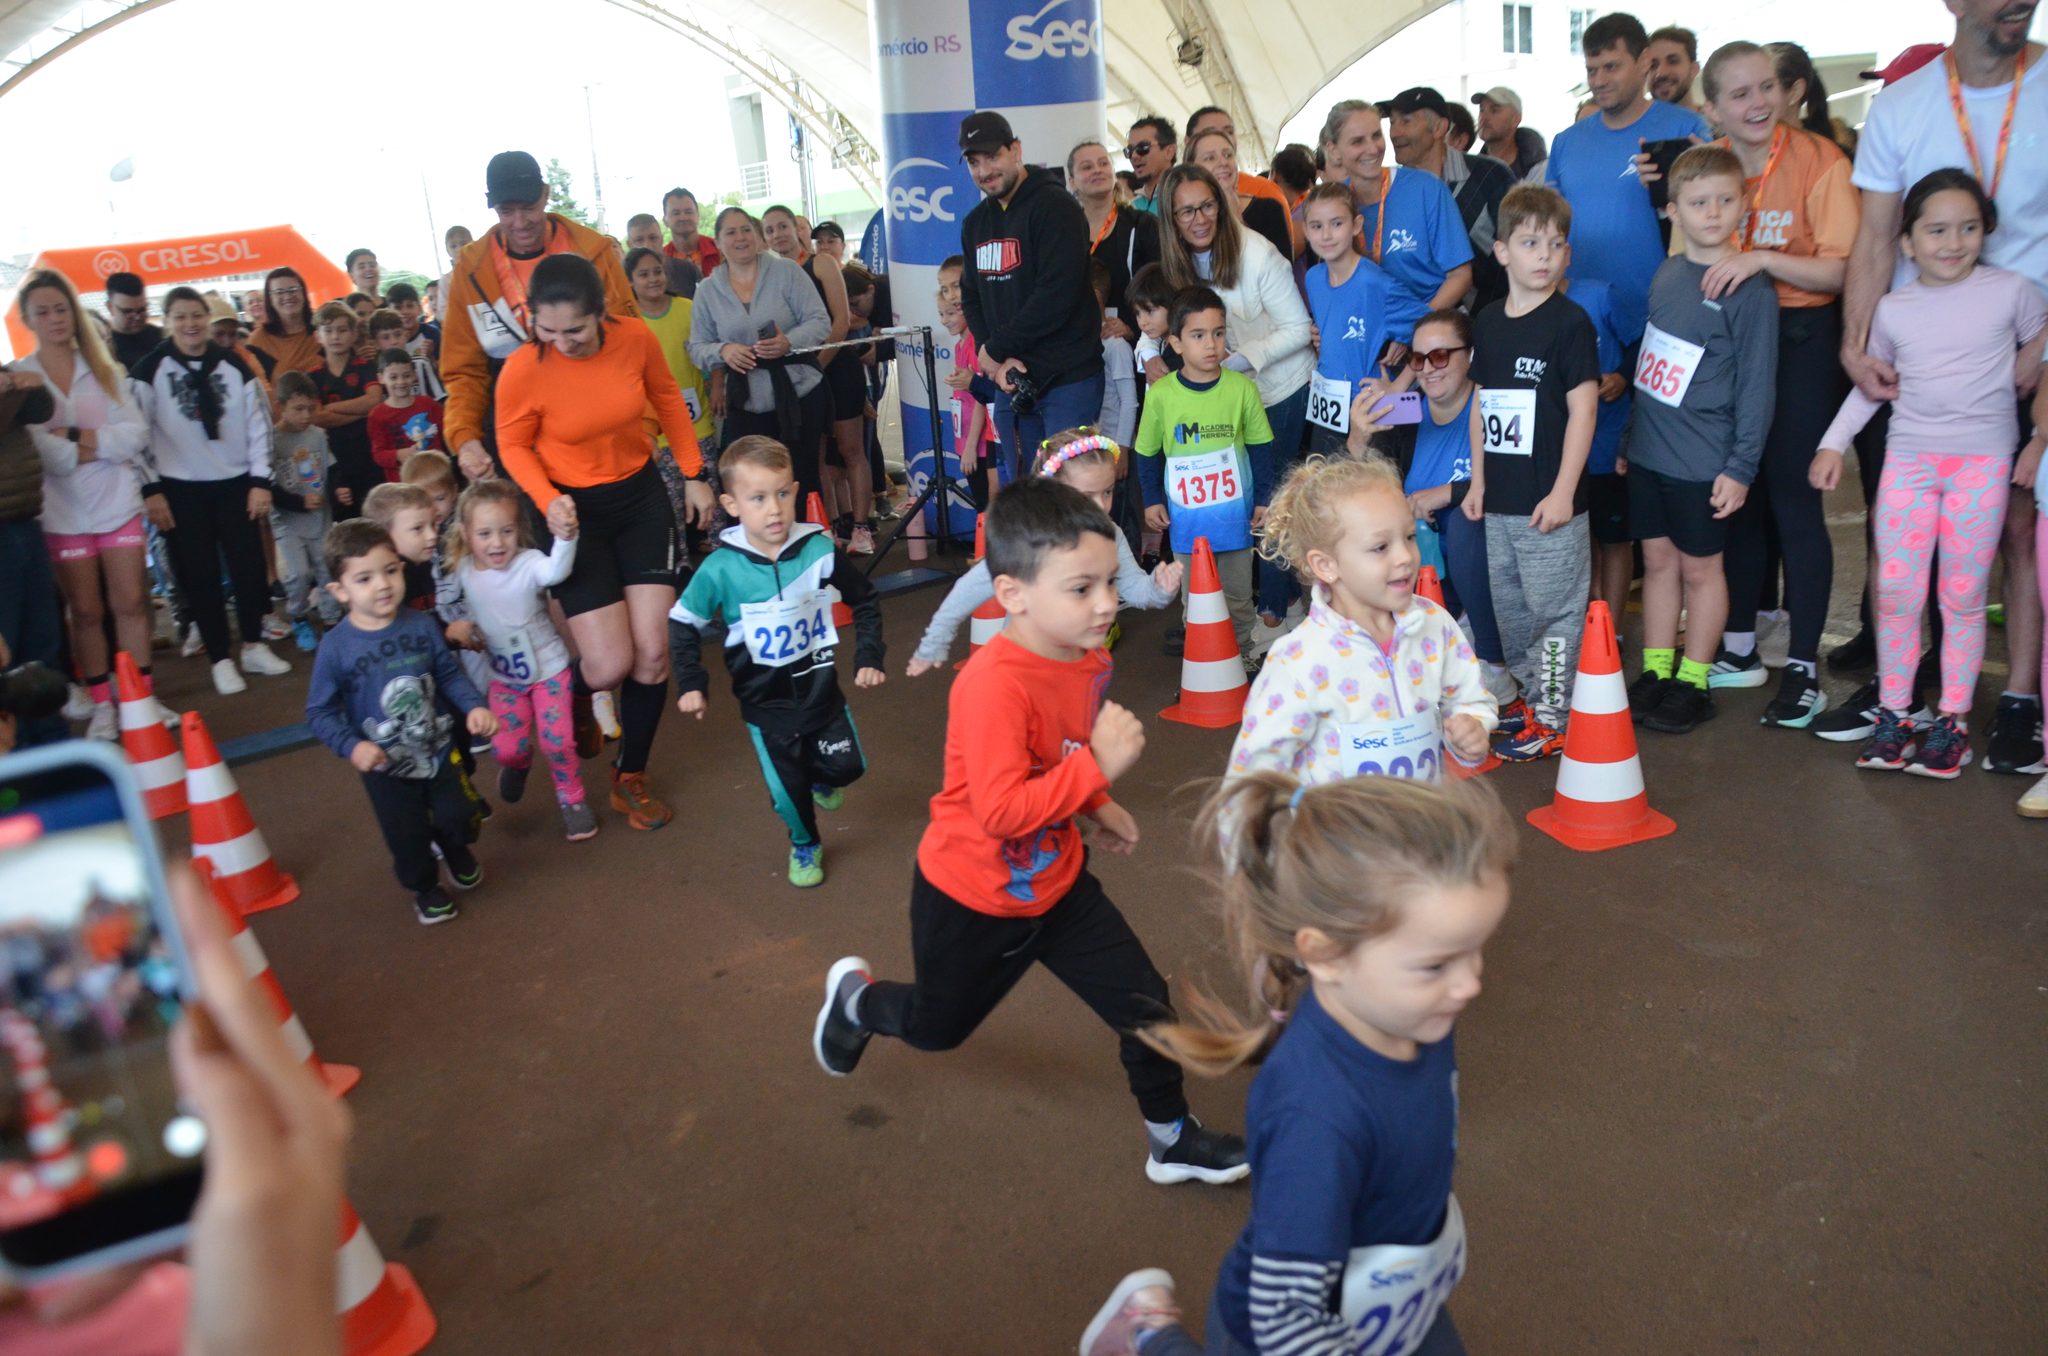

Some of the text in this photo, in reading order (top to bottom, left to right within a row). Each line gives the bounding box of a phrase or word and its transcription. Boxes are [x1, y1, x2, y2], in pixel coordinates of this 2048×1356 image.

[934, 35, 961, 53] RS
[889, 185, 955, 222] esc
[138, 238, 261, 273] CRESOL
[1635, 348, 1686, 397] 1265
[1312, 393, 1342, 427] 982
[1177, 468, 1236, 505] 1375
[754, 608, 827, 660] 2234
